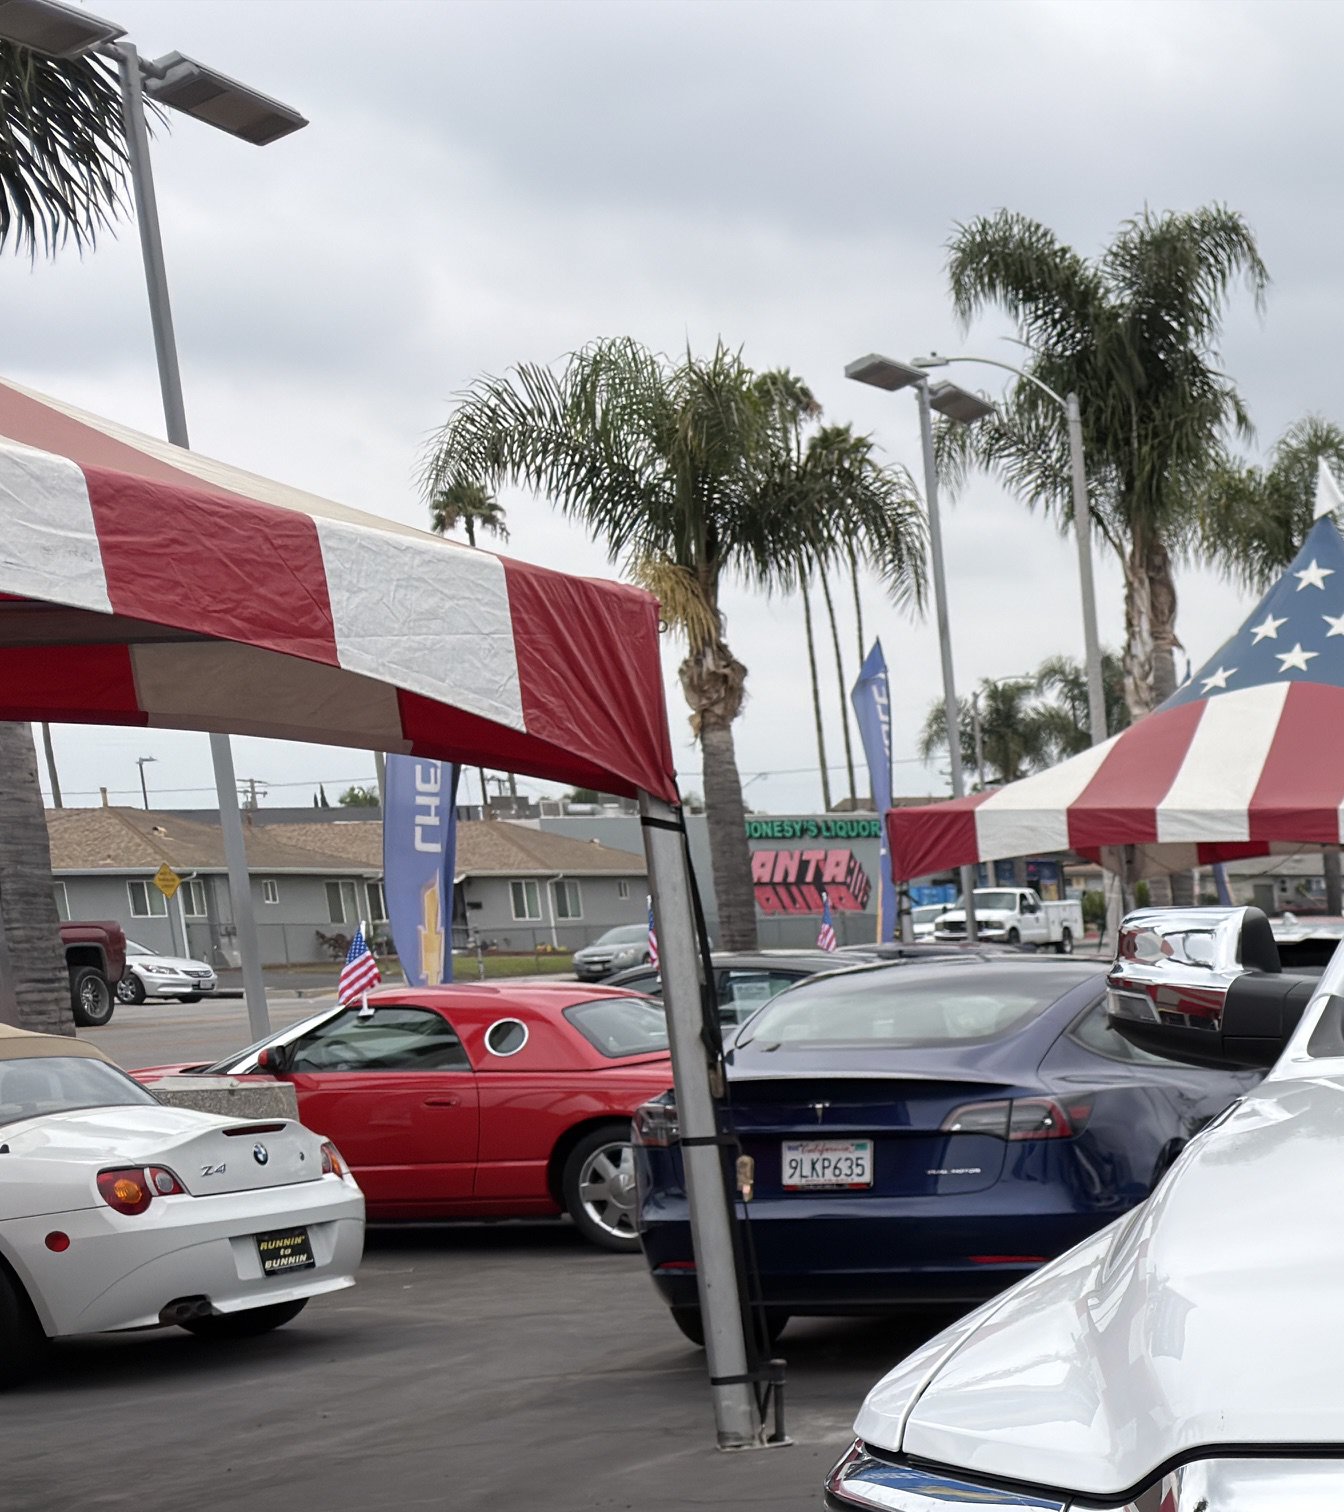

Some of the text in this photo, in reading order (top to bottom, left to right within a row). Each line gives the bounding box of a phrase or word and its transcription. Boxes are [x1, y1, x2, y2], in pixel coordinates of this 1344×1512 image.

[821, 820, 881, 839] LIQUOR
[751, 849, 852, 883] ANTA
[201, 1163, 226, 1177] Z4
[789, 1157, 865, 1179] 9LKP635
[260, 1235, 305, 1250] RUNNIN'
[280, 1248, 291, 1256] to
[265, 1254, 307, 1269] BUNNIN
